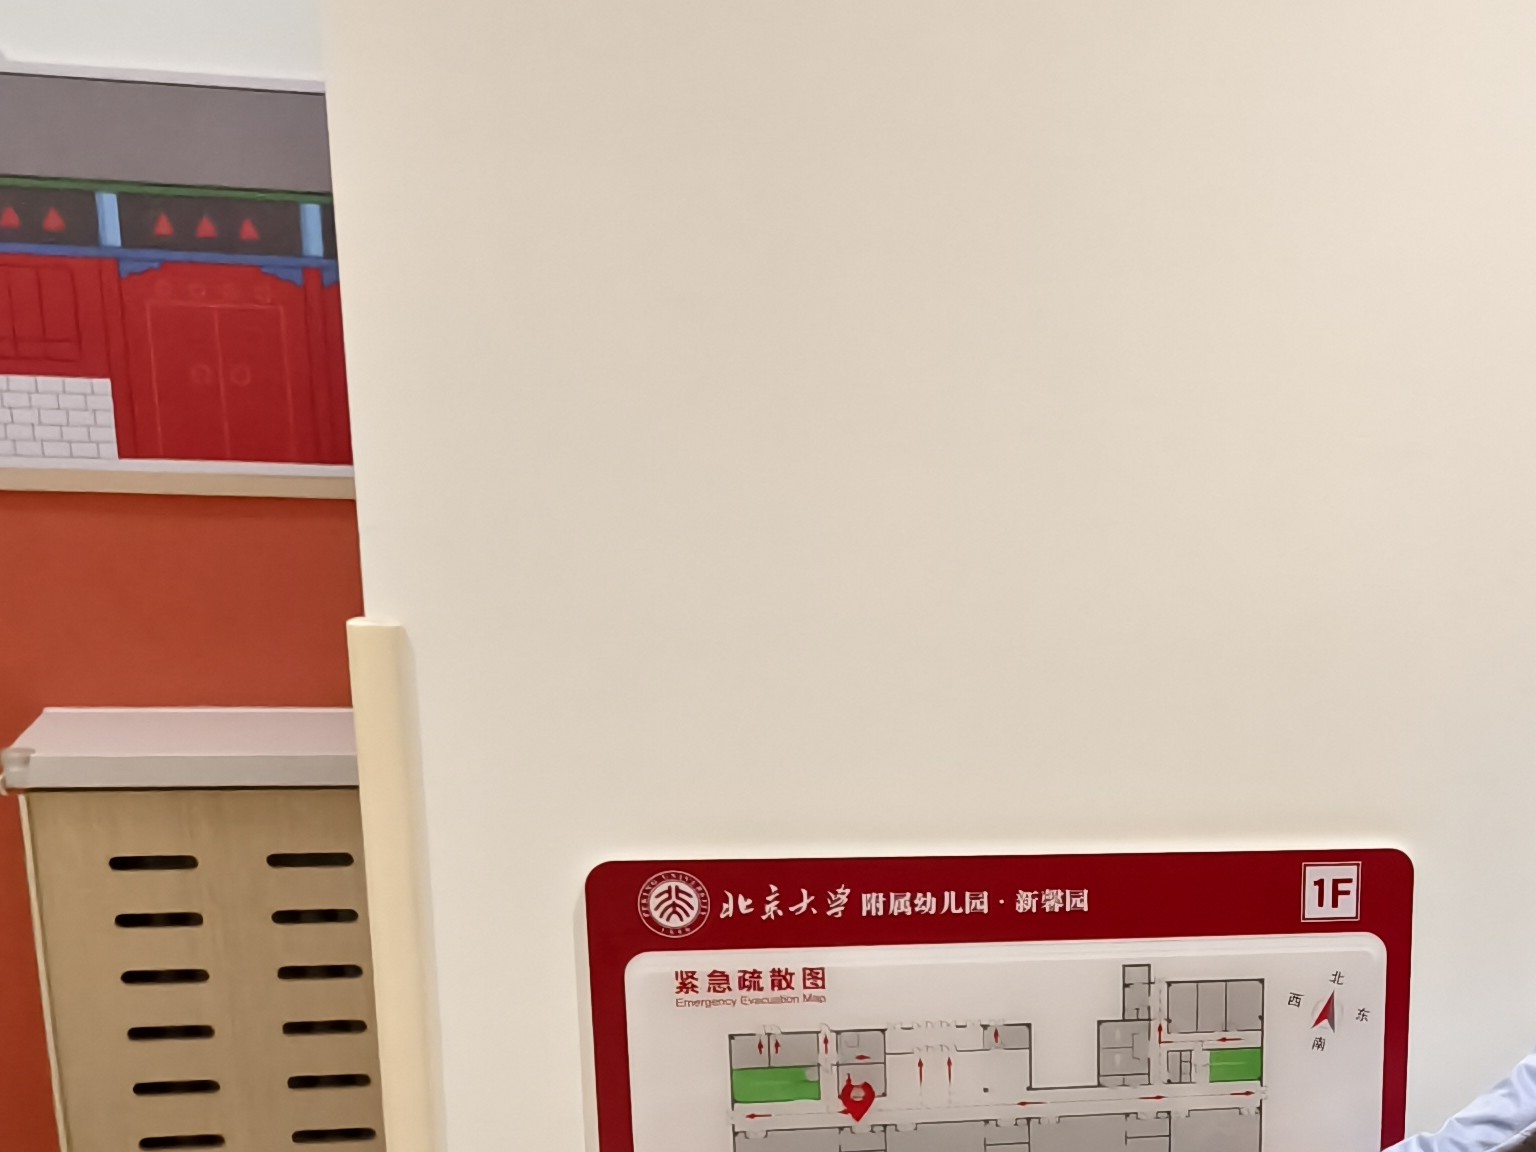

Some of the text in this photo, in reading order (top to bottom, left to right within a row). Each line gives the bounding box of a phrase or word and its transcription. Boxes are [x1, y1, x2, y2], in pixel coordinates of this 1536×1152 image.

[1313, 878, 1353, 908] 1F
[719, 884, 851, 921] 北京大学
[674, 967, 827, 995] 紧急疏散图
[1329, 970, 1345, 985] 北
[675, 993, 827, 1009] Emergency Evacuation Map
[1288, 992, 1304, 1008] 西
[1355, 1008, 1370, 1022] 东
[1312, 1036, 1326, 1051] 南
